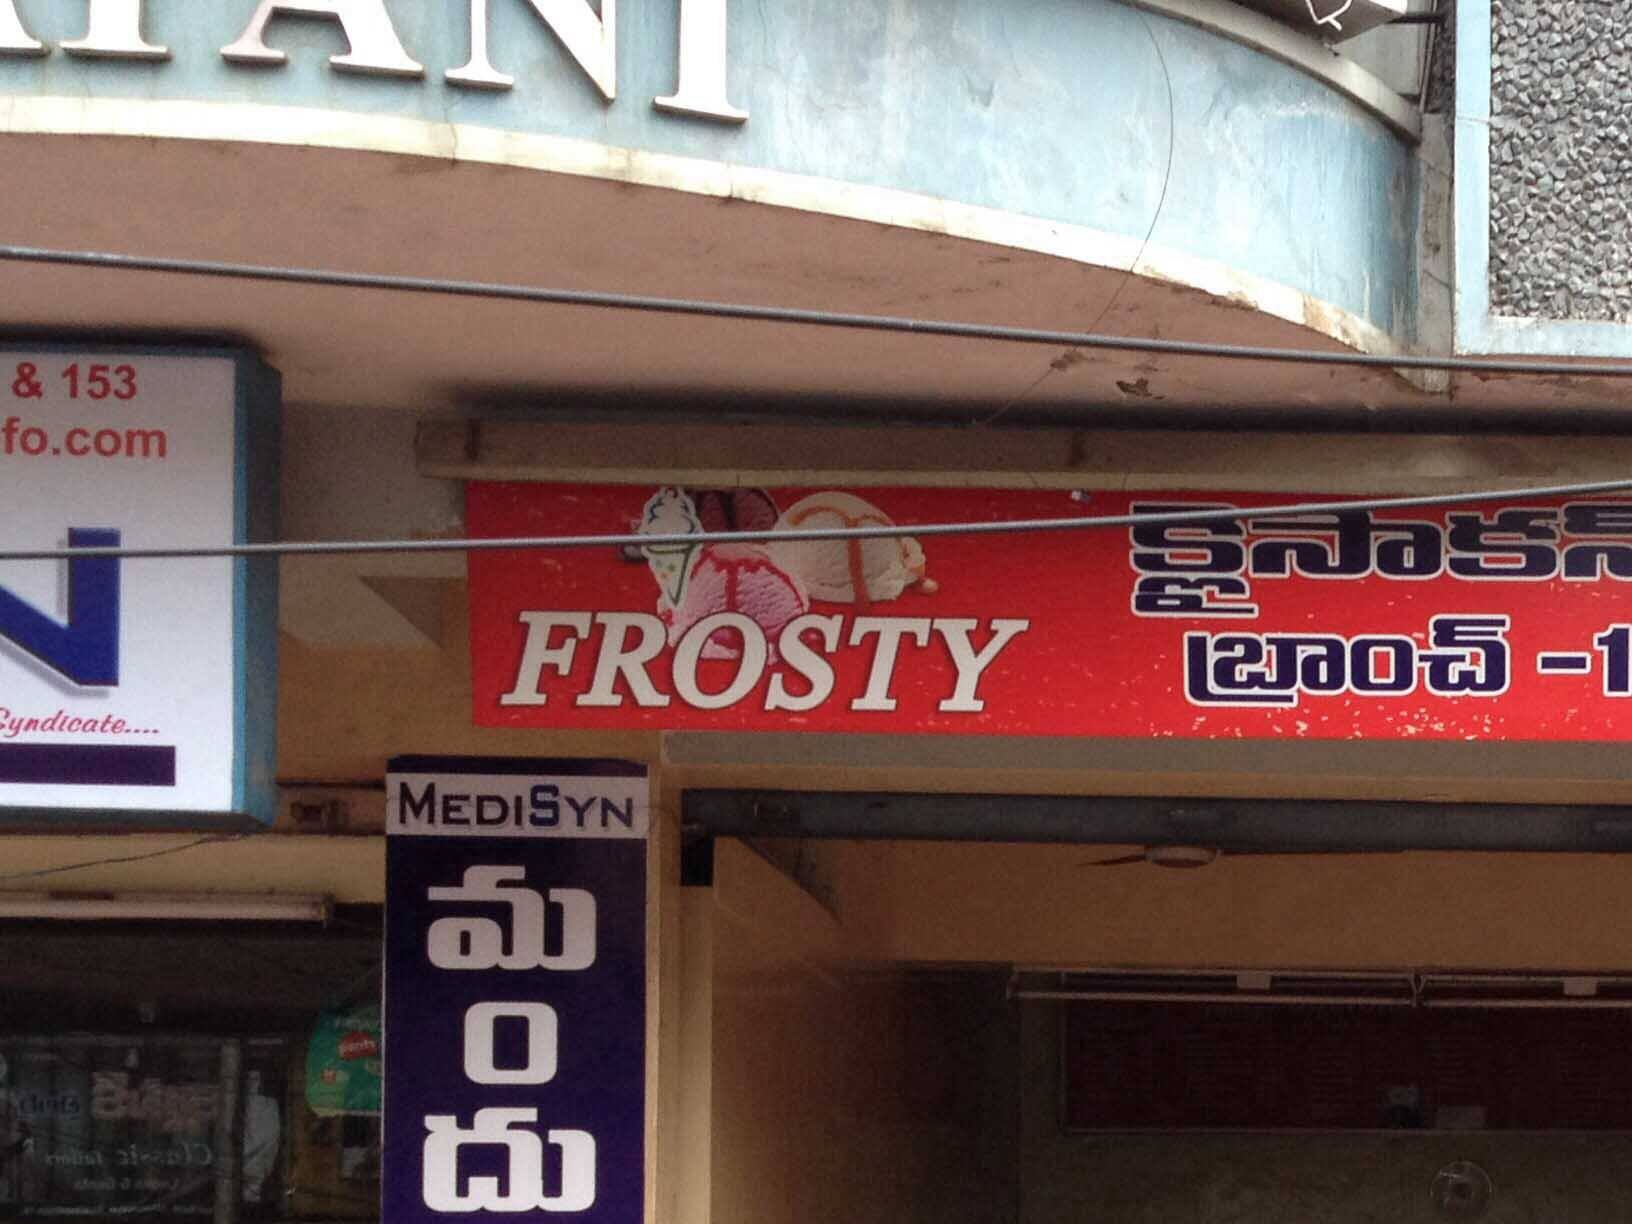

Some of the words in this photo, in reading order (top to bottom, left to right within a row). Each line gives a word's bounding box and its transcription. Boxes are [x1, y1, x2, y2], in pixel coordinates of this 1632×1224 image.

[12, 363, 42, 398] &
[61, 364, 137, 400] 153
[499, 610, 1029, 712] FROSTY
[1184, 615, 1510, 706] బ్రాంచ్
